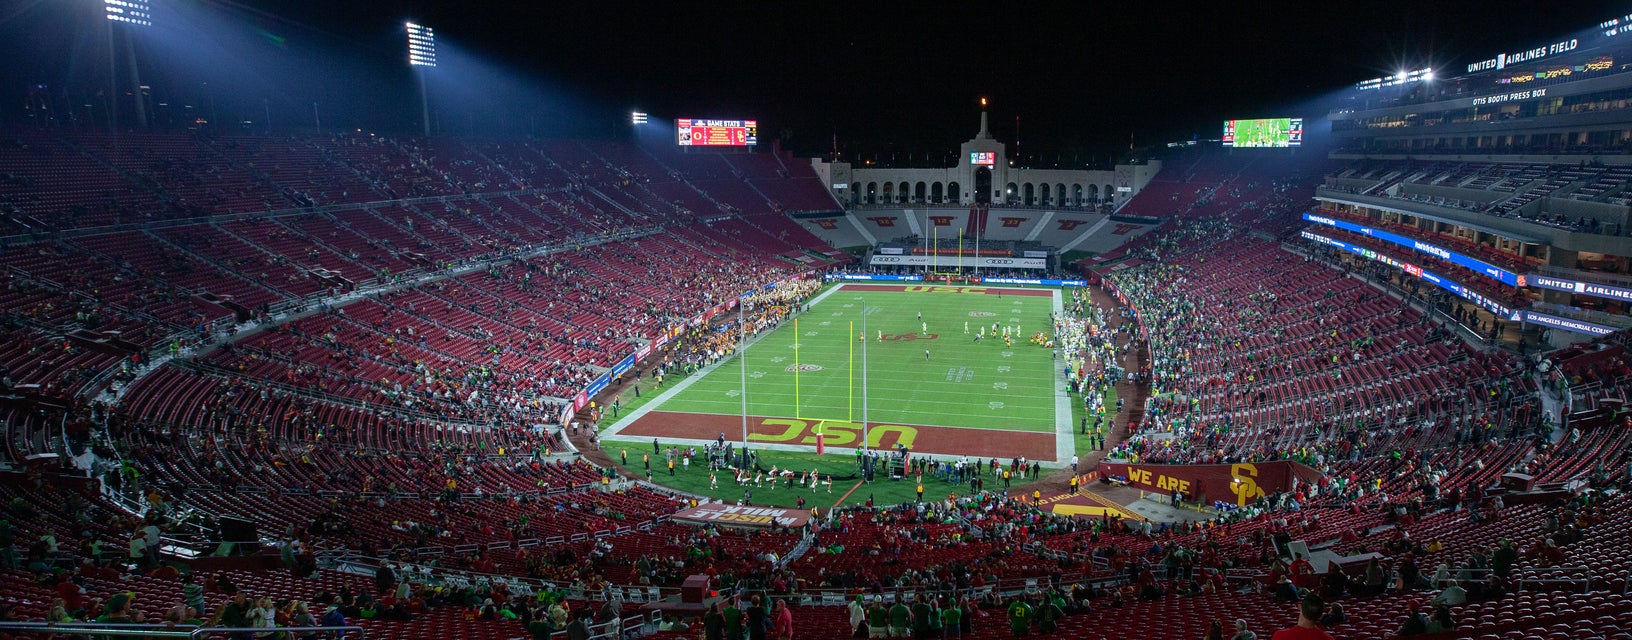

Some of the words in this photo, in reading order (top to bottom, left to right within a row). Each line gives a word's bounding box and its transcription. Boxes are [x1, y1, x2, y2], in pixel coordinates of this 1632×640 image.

[1468, 58, 1497, 73] UNITED
[1506, 46, 1547, 65] AIRLINES
[1550, 39, 1578, 55] FIELD
[1473, 97, 1486, 106] OTIS
[1487, 94, 1508, 104] BOOTH
[1509, 91, 1530, 101] PRESS
[1532, 89, 1547, 98] BOX
[904, 286, 986, 294] USC
[1538, 278, 1574, 289] UNITED
[1538, 316, 1561, 326] ANGELES
[1561, 320, 1591, 332] MEMORIAL
[746, 418, 918, 450] USC
[1127, 466, 1153, 486] WE
[1156, 474, 1191, 495] ARE
[688, 510, 798, 526] MUSCLE
[720, 505, 788, 517] MILK
[1015, 606, 1025, 618] 21
